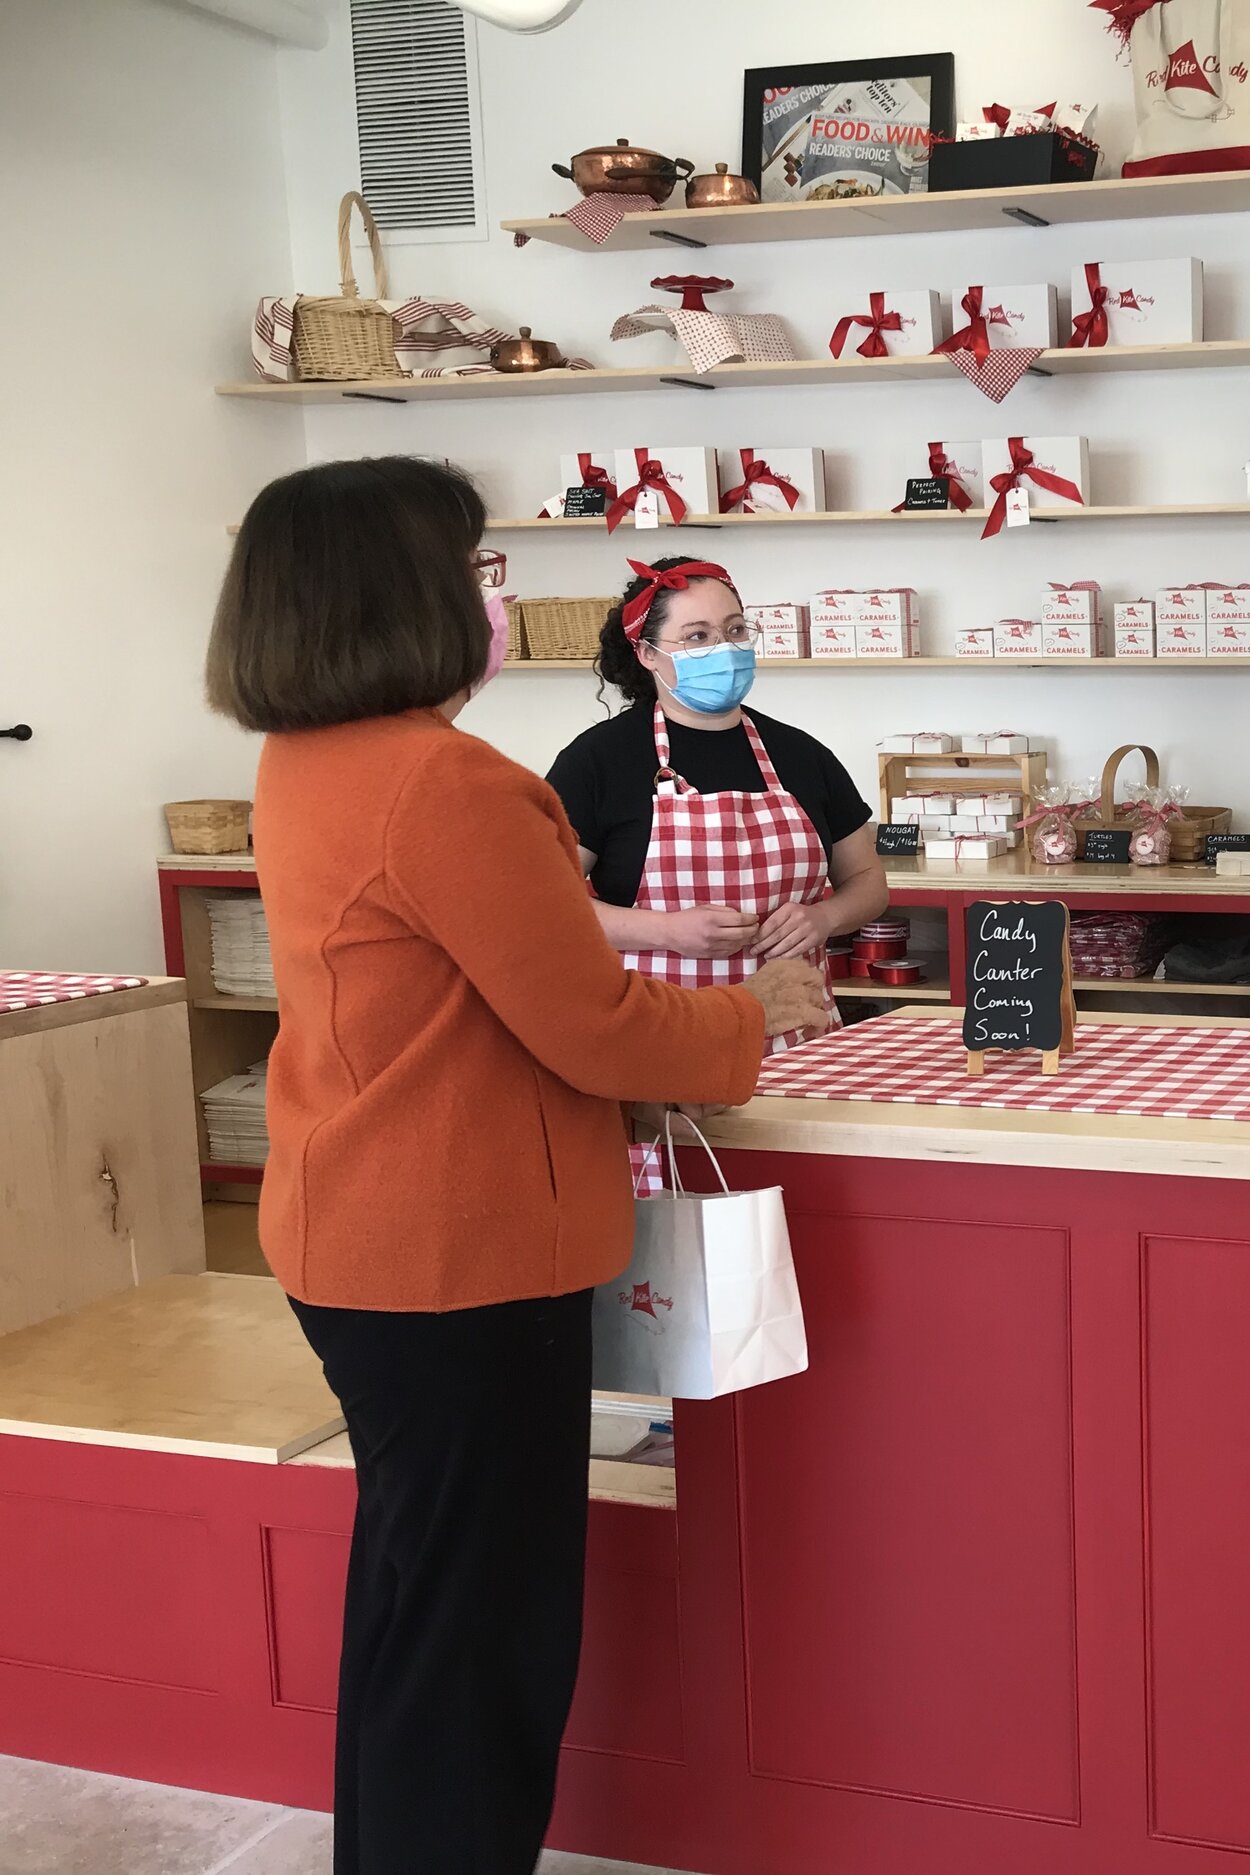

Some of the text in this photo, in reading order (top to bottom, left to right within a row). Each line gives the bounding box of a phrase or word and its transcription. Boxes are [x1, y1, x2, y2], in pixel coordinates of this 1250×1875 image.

[1170, 58, 1197, 78] Kite
[1202, 55, 1249, 83] Cady
[811, 118, 870, 141] FOOD
[871, 127, 884, 144] &
[886, 124, 931, 147] WIN
[855, 146, 891, 162] CHOICE
[885, 826, 916, 834] NOUGAT
[1207, 835, 1245, 843] CARAMELS
[980, 909, 1037, 953] Candy
[973, 987, 1034, 1017] Coming
[974, 1018, 1031, 1041] Soon!
